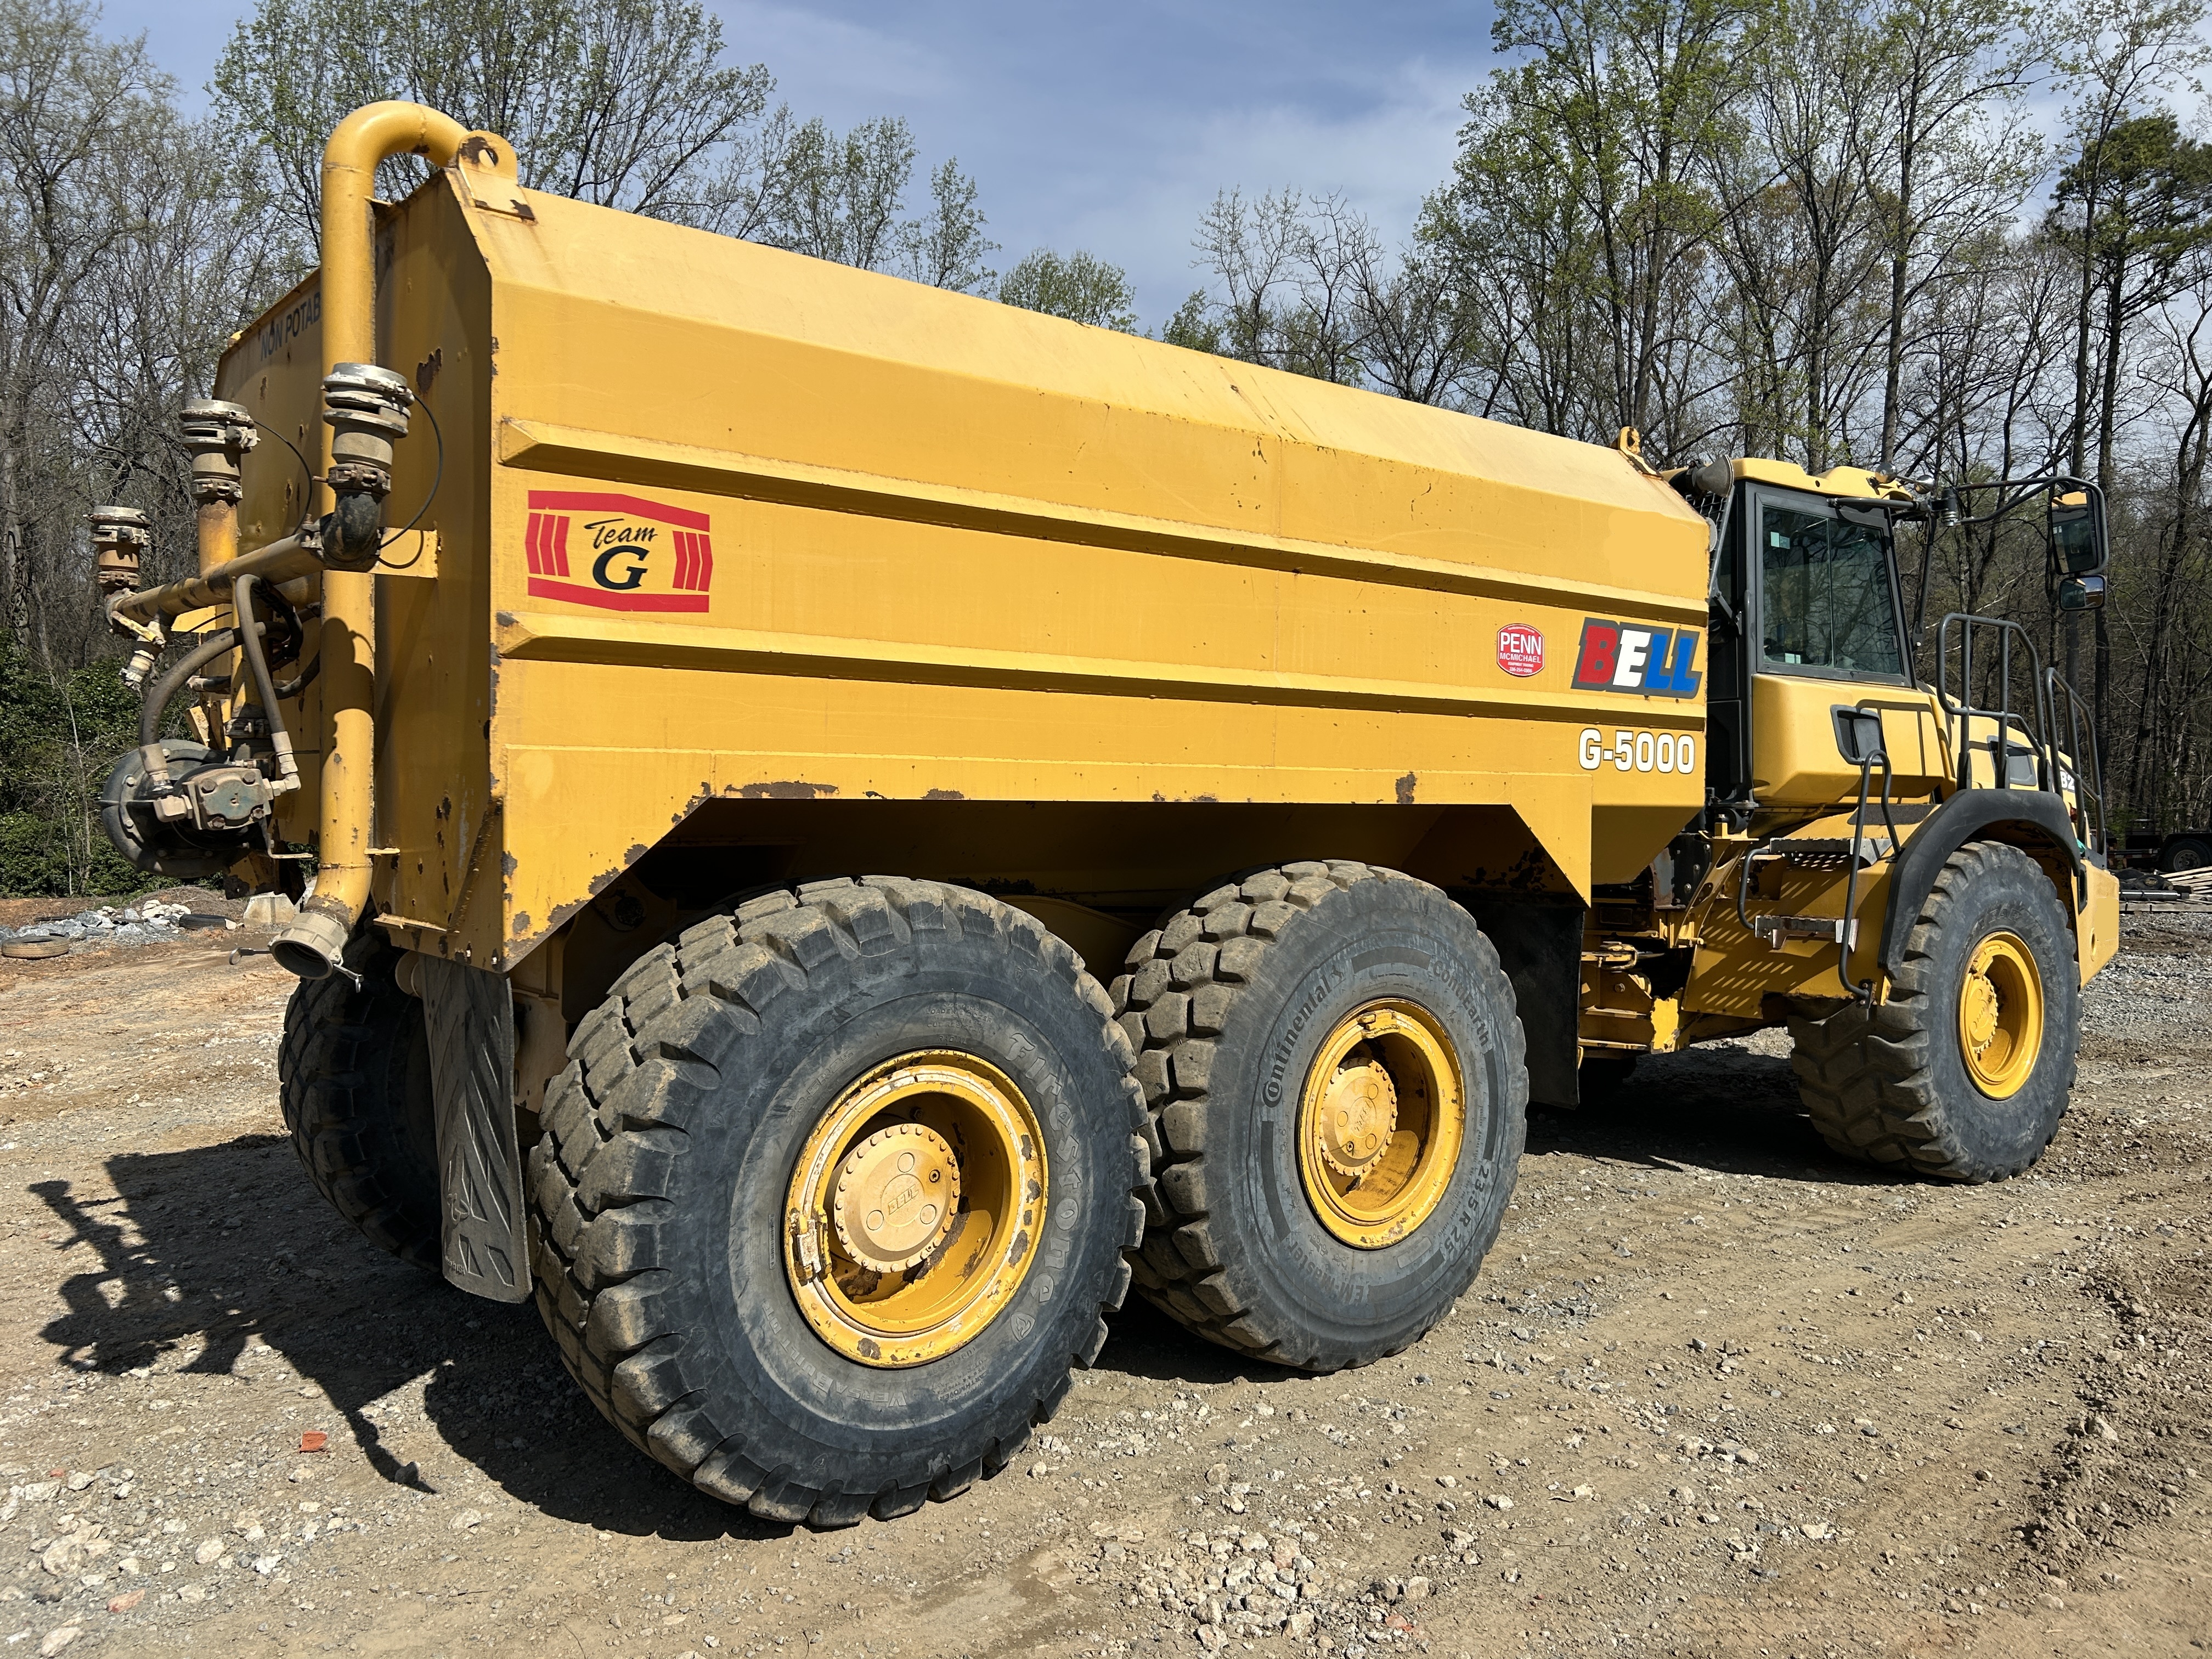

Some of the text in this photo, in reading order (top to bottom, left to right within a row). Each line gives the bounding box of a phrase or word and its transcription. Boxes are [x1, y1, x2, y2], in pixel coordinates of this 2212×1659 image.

[261, 291, 321, 362] NON POTAB
[584, 518, 658, 549] Team
[592, 545, 650, 590] G
[1499, 652, 1542, 663] MCMICHAEL
[1500, 631, 1542, 655] PENN
[1576, 624, 1698, 693] BELL
[1578, 727, 1695, 775] G-5000
[1262, 974, 1332, 1108] Continental
[1004, 1032, 1081, 1303] Firestone
[1468, 1165, 1489, 1211] 23.5
[888, 1183, 919, 1216] BELL
[1459, 1211, 1471, 1227] R
[1444, 1226, 1462, 1254] 25
